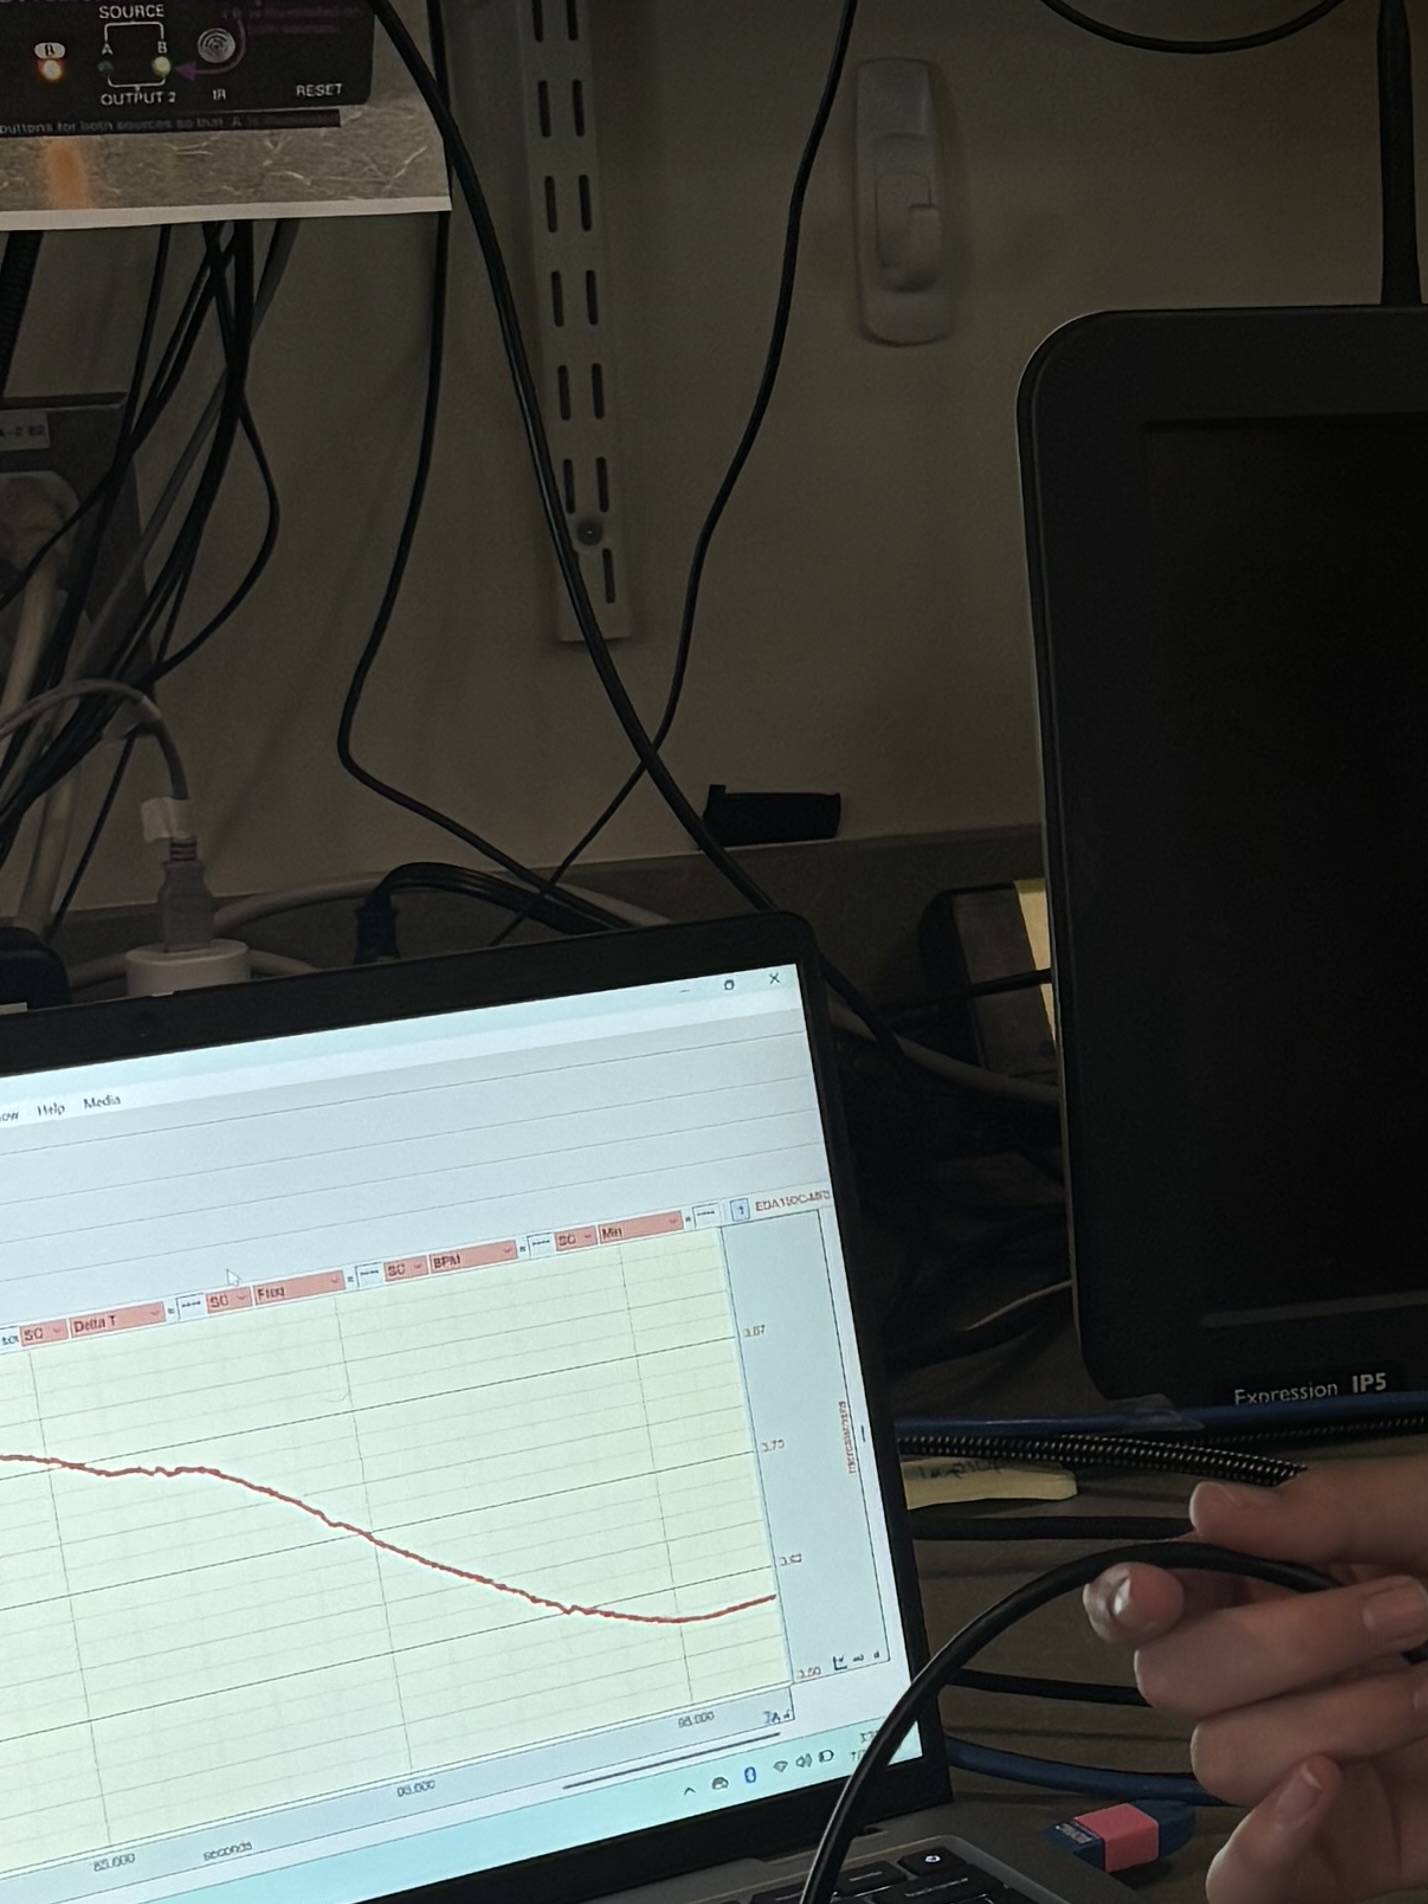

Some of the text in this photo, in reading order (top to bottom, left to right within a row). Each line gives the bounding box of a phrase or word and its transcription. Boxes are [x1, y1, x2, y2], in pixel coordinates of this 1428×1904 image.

[99, 5, 164, 18] SOURCE
[101, 43, 114, 56] A
[157, 41, 168, 54] B
[296, 83, 343, 97] RESET
[101, 92, 161, 106] OUTPUT
[37, 1102, 65, 1117] Help
[83, 1094, 121, 1110] Media
[74, 1315, 116, 1334] Delta T
[1352, 1372, 1387, 1394] IP5
[203, 1841, 252, 1862] seconds
